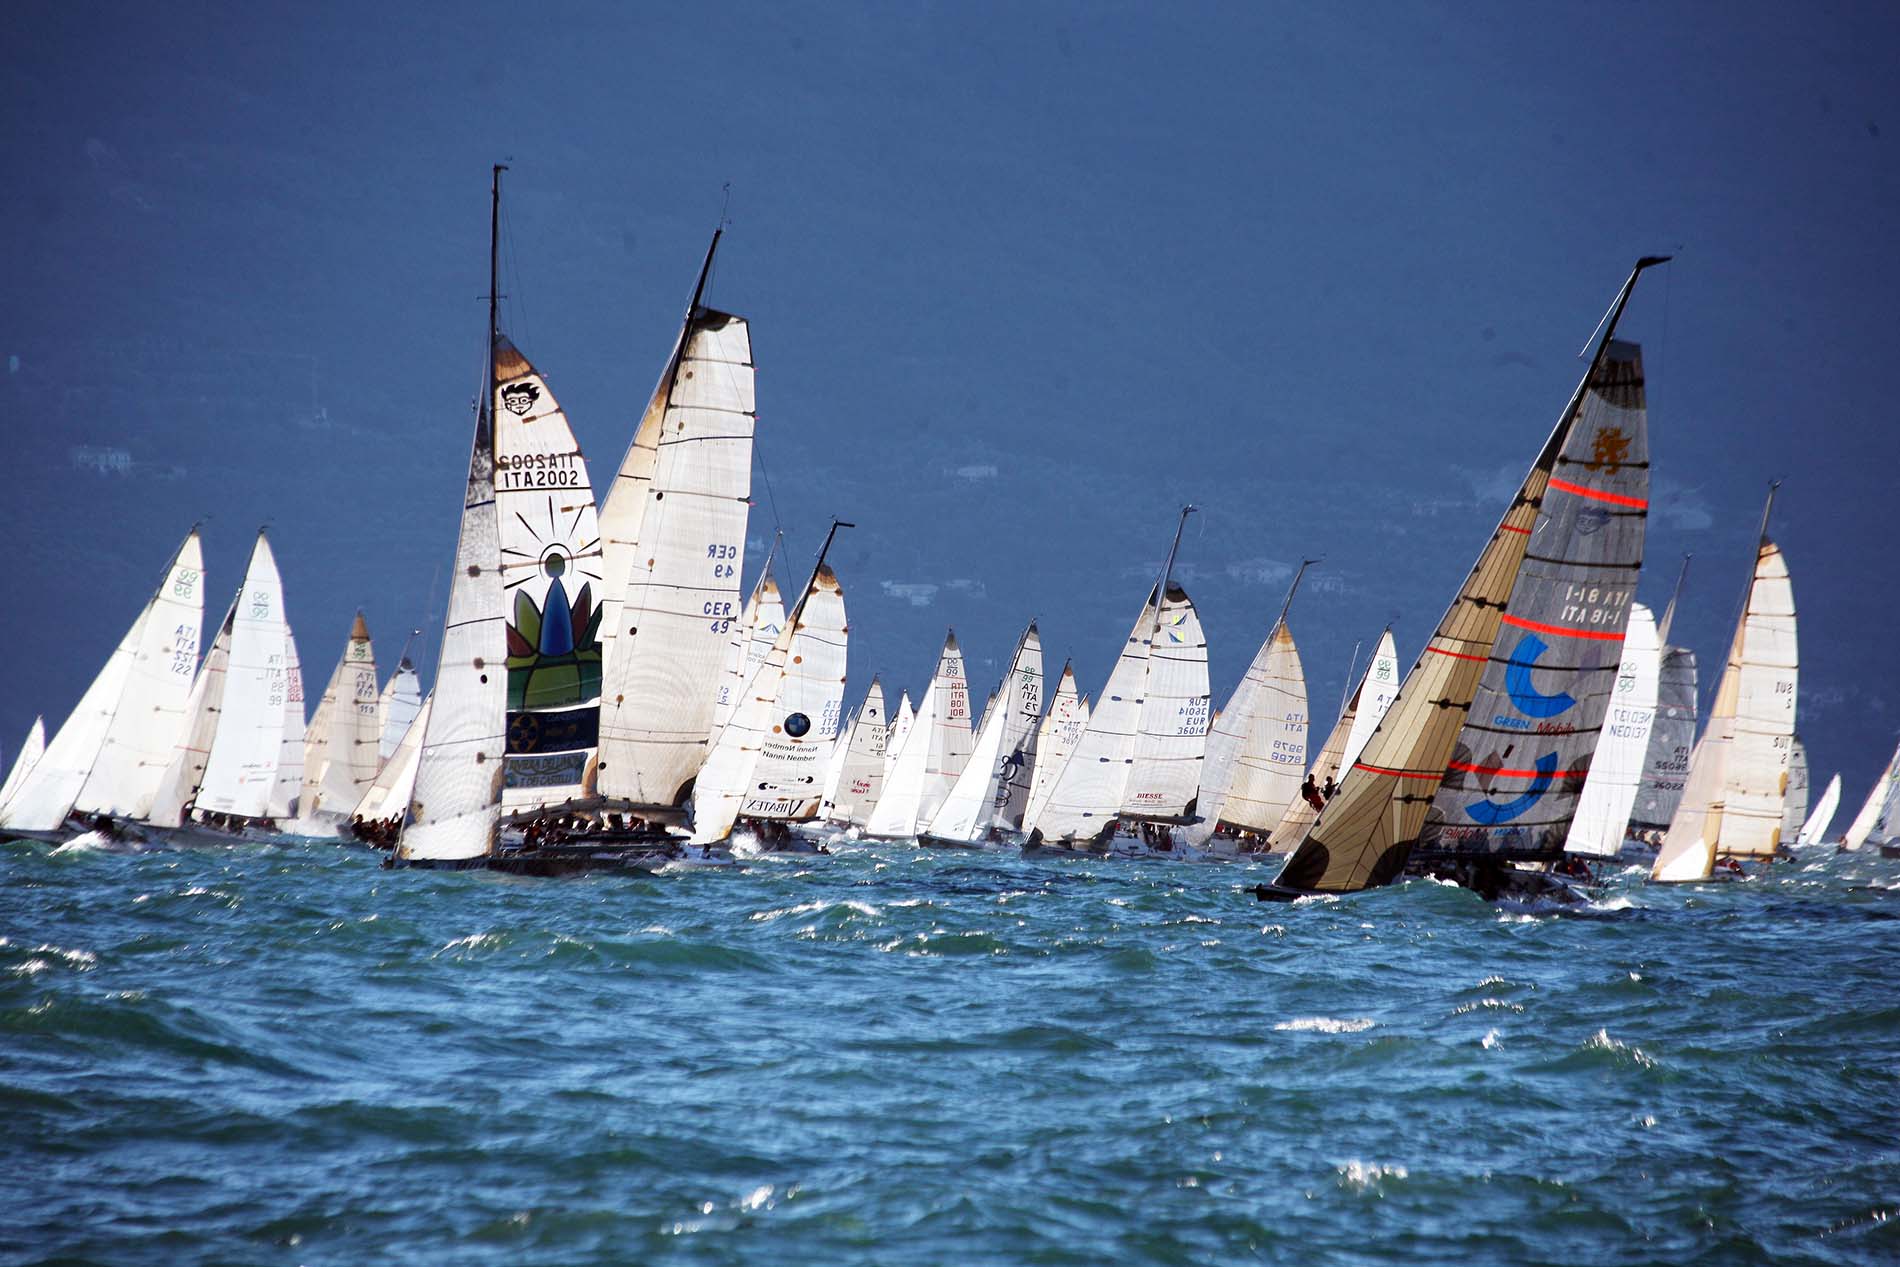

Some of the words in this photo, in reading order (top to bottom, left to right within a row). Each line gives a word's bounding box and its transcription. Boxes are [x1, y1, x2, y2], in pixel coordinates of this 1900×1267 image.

[504, 470, 578, 488] ITA2002
[1560, 604, 1587, 624] ITA
[710, 620, 729, 634] 49
[171, 662, 191, 676] 122
[1022, 691, 1037, 701] ITA
[1186, 717, 1206, 726] EUR
[1284, 723, 1303, 732] ITA
[1494, 715, 1530, 729] GREEN
[1177, 726, 1205, 735] 36014
